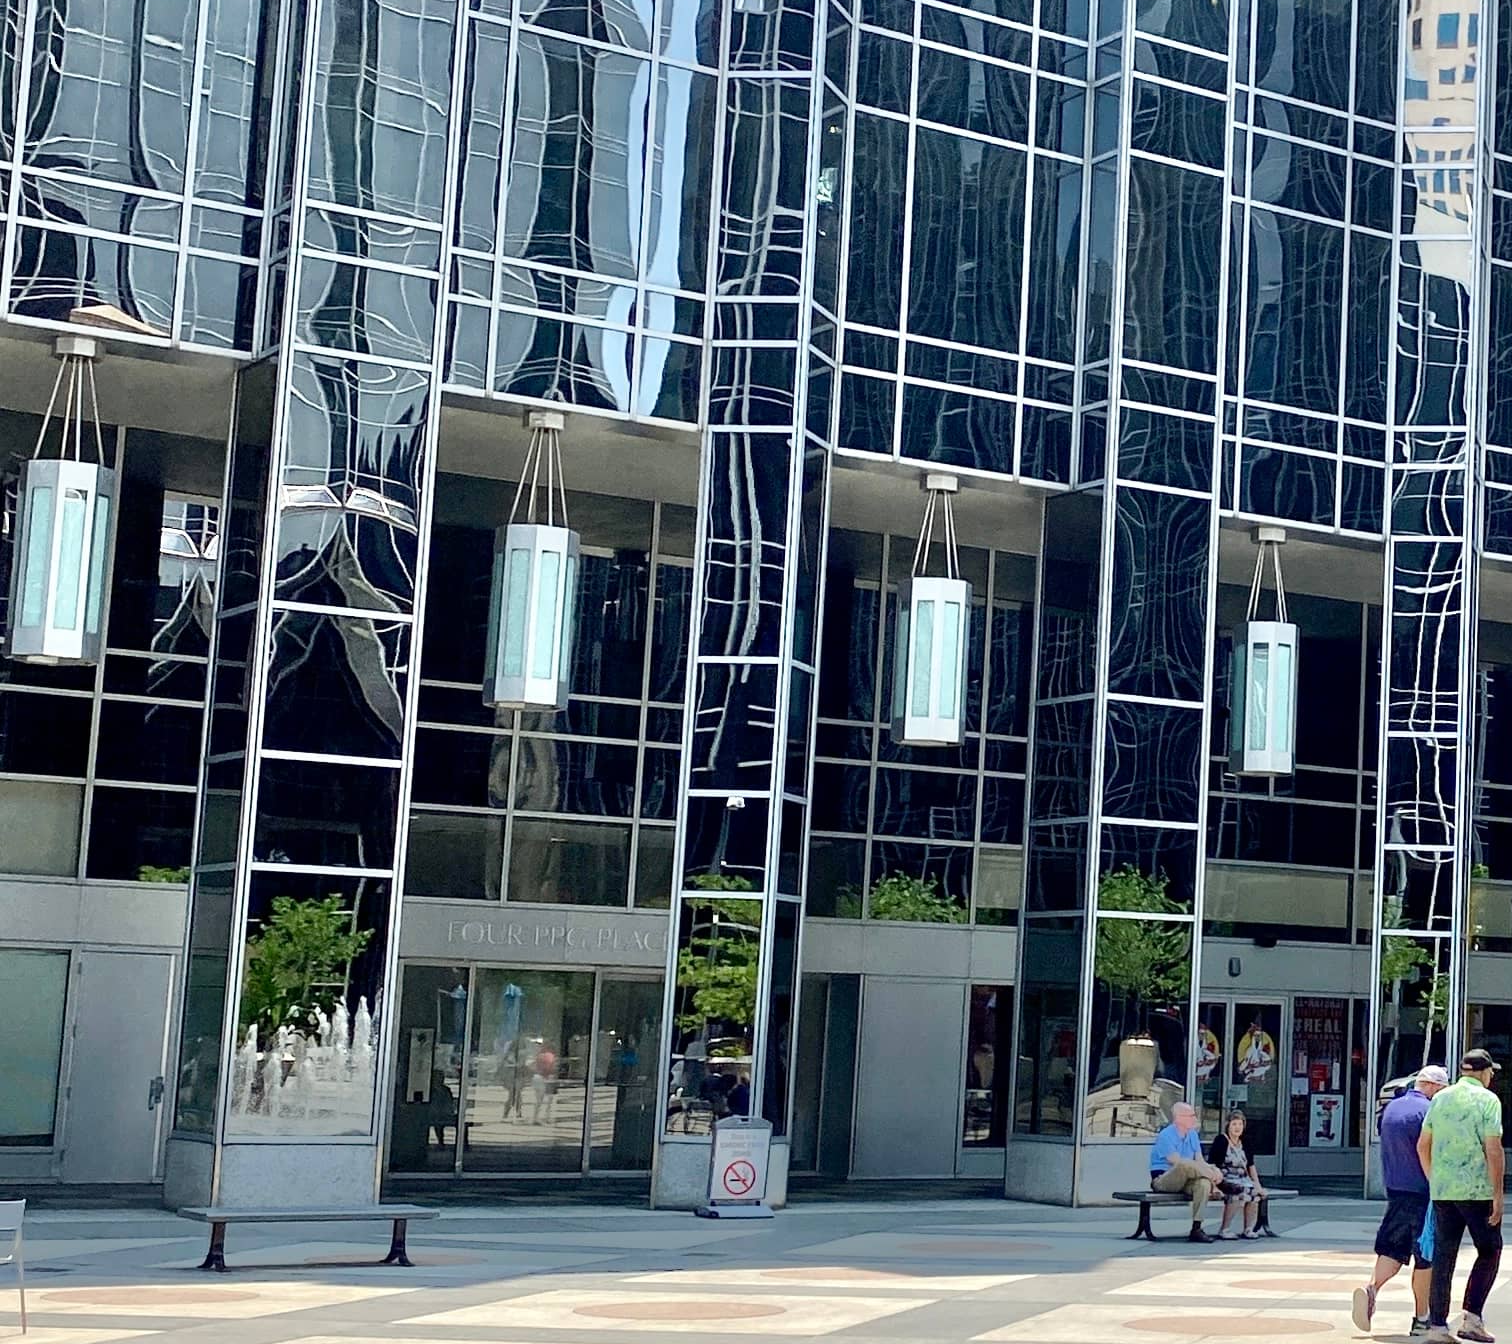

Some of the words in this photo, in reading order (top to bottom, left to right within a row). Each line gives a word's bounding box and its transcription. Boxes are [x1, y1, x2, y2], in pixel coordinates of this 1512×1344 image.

[448, 919, 523, 946] FOUR
[533, 924, 586, 949] PPG
[597, 928, 668, 953] PLAC
